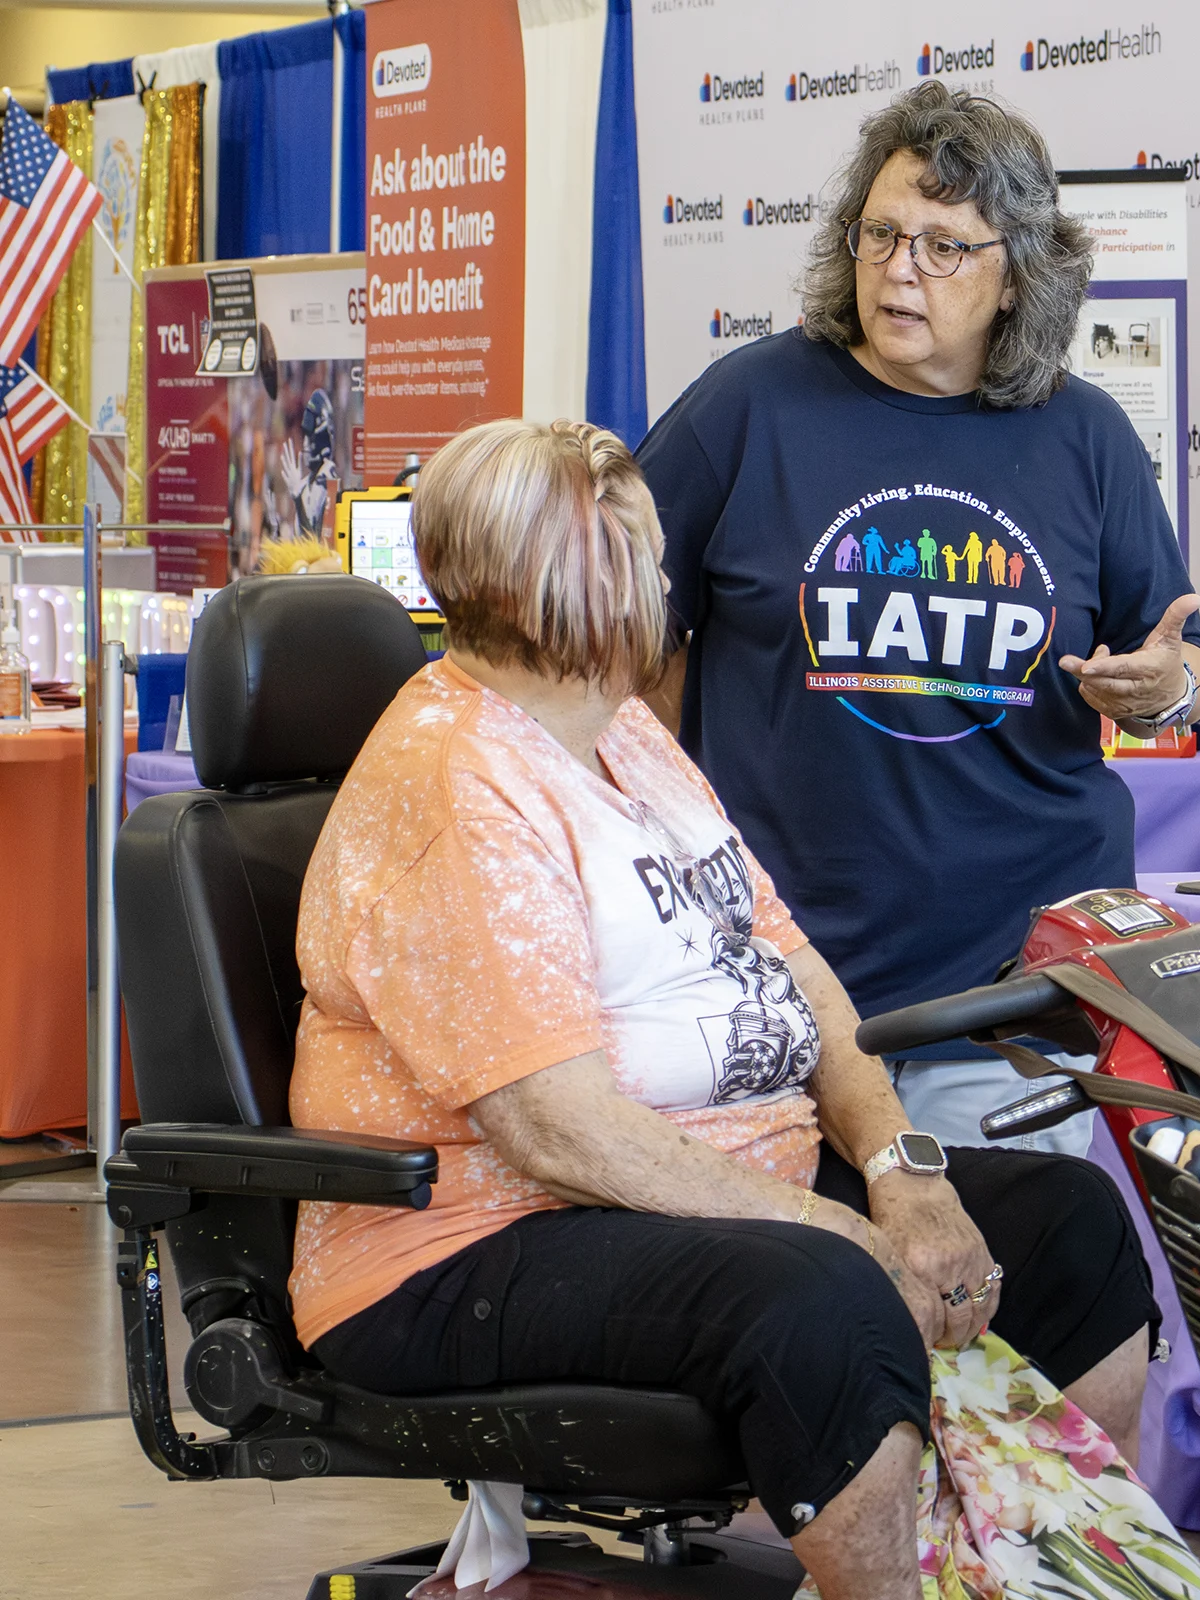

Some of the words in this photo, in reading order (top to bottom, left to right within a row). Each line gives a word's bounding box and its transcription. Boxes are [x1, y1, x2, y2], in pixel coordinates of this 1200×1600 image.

[386, 55, 426, 85] Devoted
[934, 39, 995, 74] Devoted
[713, 71, 764, 101] Devoted
[371, 103, 403, 119] HEALTH
[699, 112, 733, 126] HEALTH
[736, 108, 765, 122] PLANS
[371, 148, 407, 197] Ask
[410, 143, 466, 192] about
[469, 134, 506, 184] the
[675, 194, 724, 223] Devoted
[1097, 210, 1117, 219] with
[1119, 208, 1169, 219] Disabilities
[370, 206, 416, 257] Food
[419, 207, 436, 252] &
[442, 206, 495, 250] Home
[1088, 227, 1128, 236] Enhance
[1102, 242, 1164, 253] Participation
[1166, 241, 1175, 251] in
[369, 266, 413, 317] Card
[417, 262, 484, 314] benefit
[158, 323, 190, 354] TCL
[723, 310, 773, 339] Devoted
[804, 503, 862, 574] Community
[860, 487, 912, 510] Living.
[914, 483, 991, 515] Education.
[993, 509, 1056, 596] Employment.
[817, 587, 1045, 670] IATP
[809, 676, 859, 687] ILLINOIS
[862, 677, 918, 689] ASSISTIVE
[919, 681, 990, 699] TECHNOLOGY
[992, 690, 1032, 703] PROGRAM
